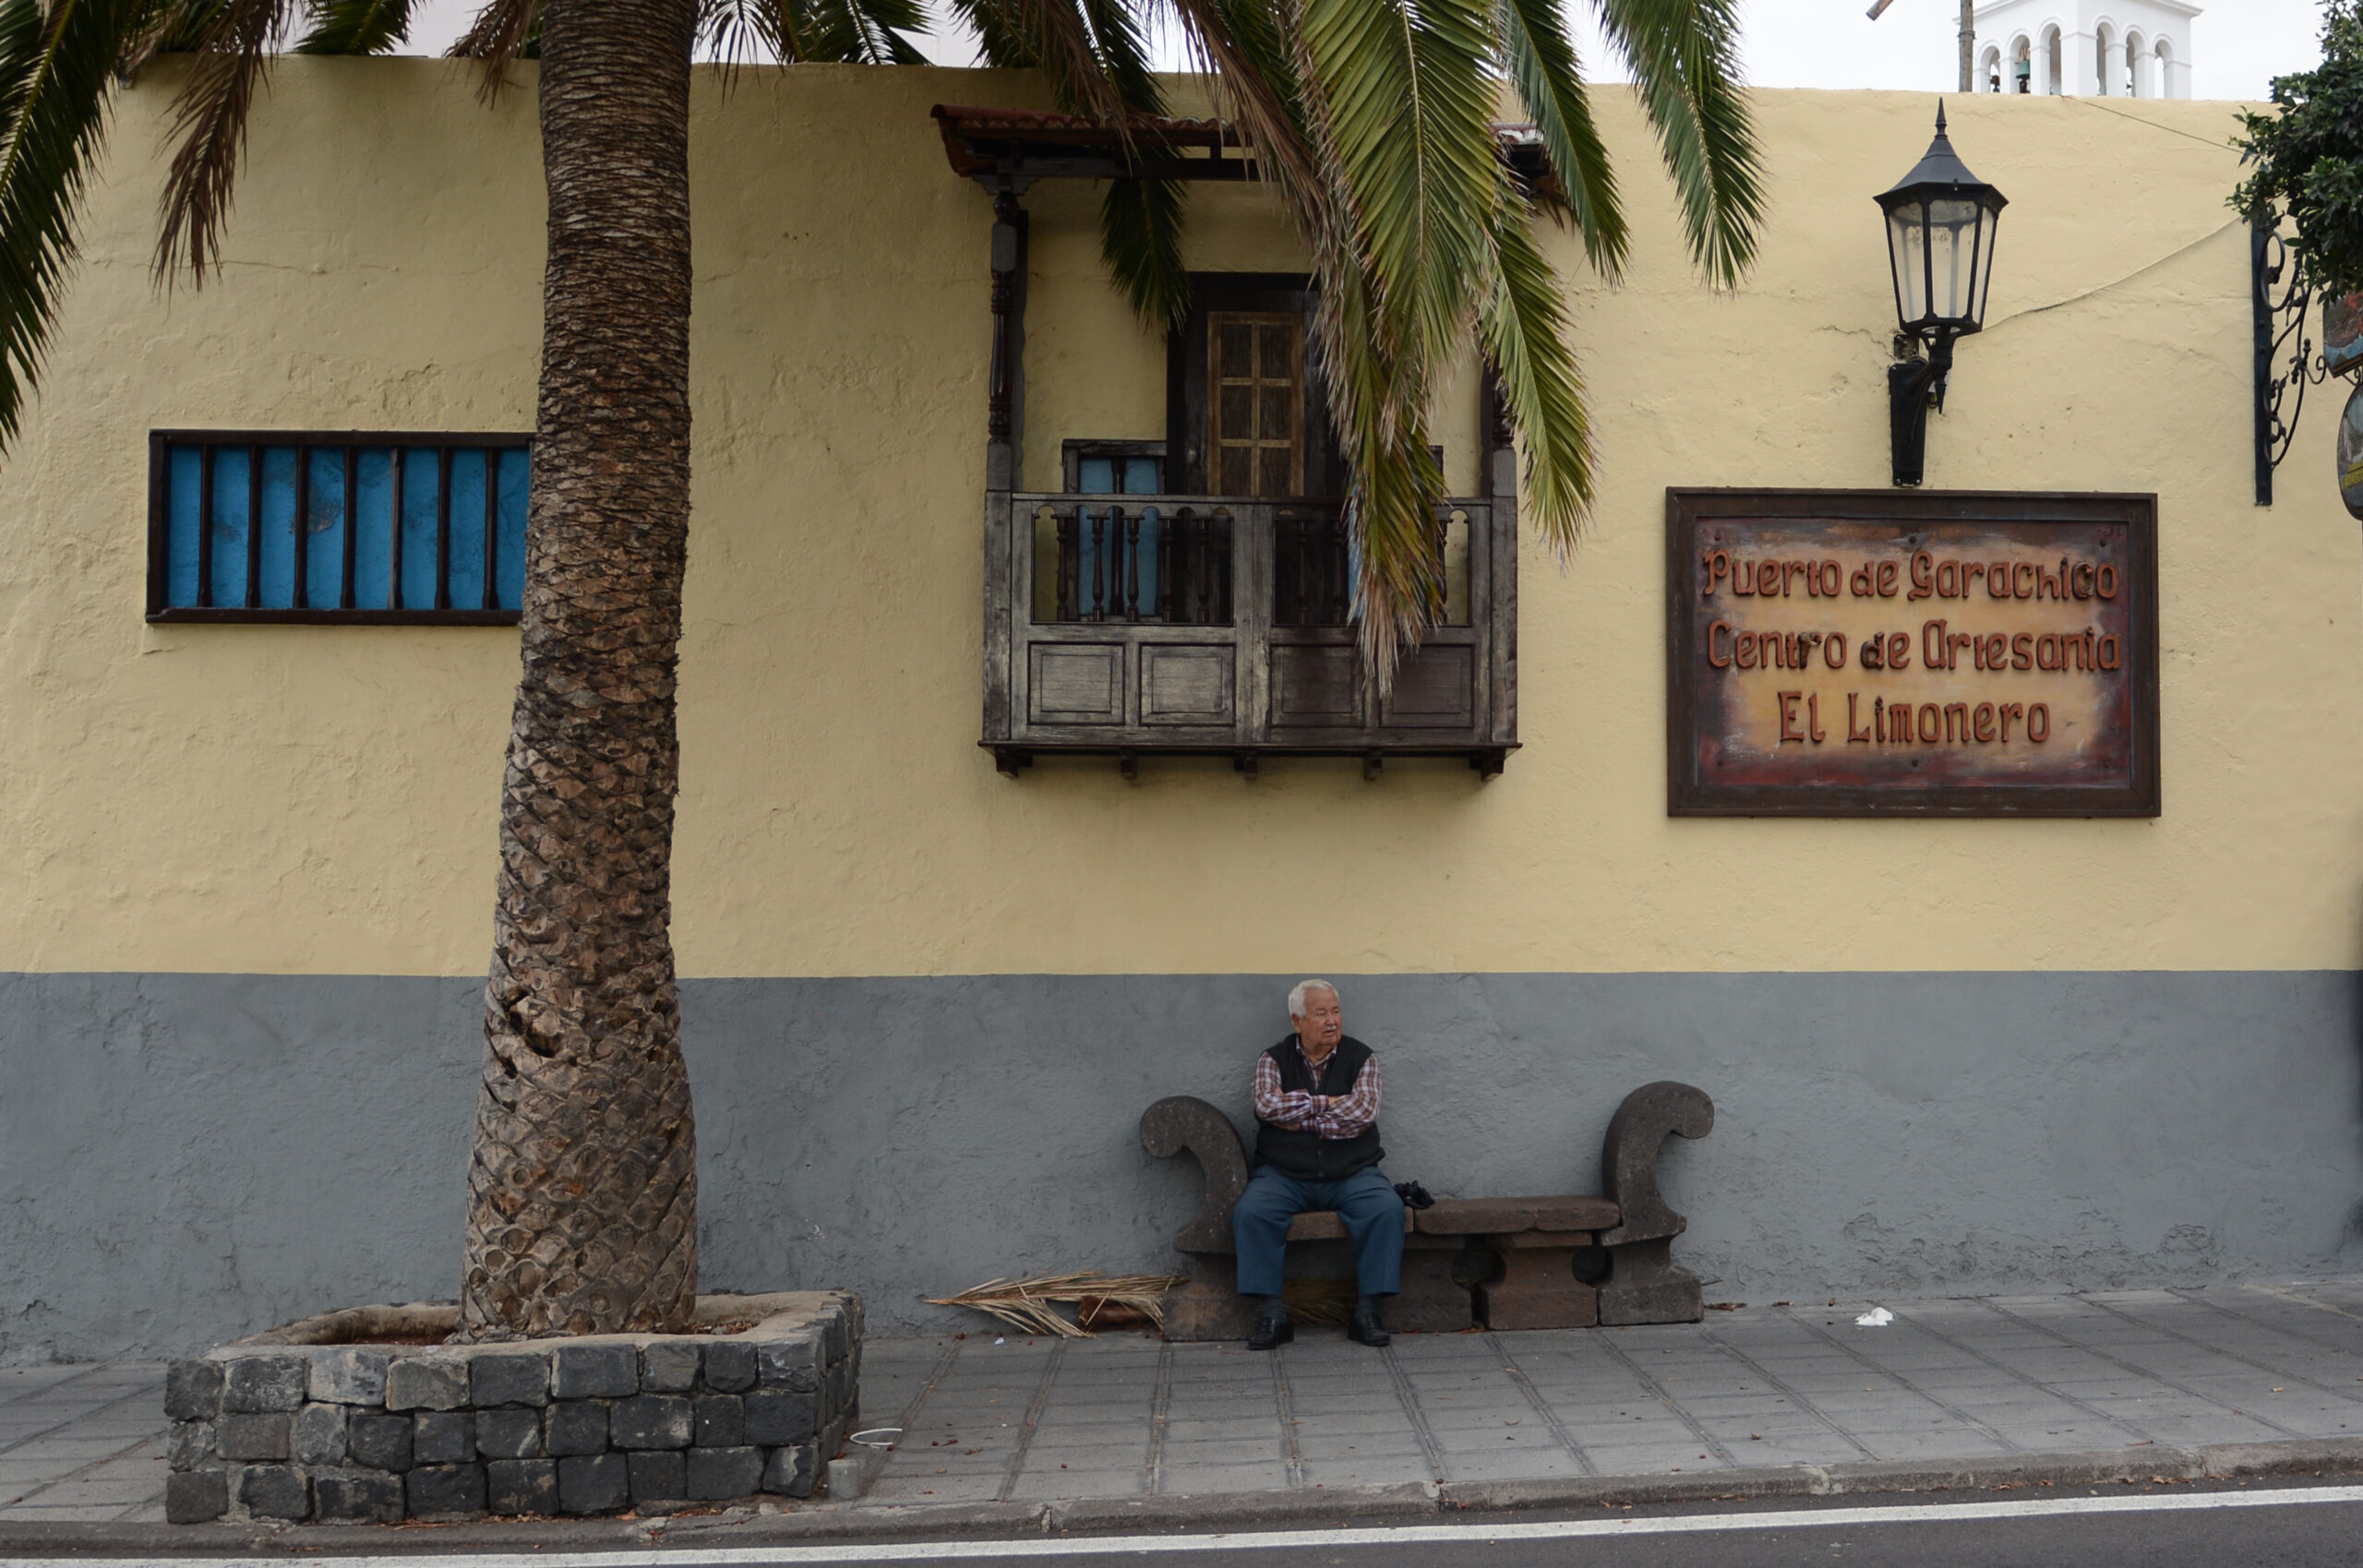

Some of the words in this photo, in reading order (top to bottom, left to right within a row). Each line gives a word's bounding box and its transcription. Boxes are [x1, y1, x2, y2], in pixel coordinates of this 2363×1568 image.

[1703, 548, 1842, 597] Puerto
[1851, 560, 1899, 596] de
[1907, 550, 2119, 600] Garachico
[1709, 619, 1846, 669] Centro
[1861, 631, 1911, 670] de
[1777, 691, 1826, 742] El
[1847, 692, 2051, 743] Limonero
